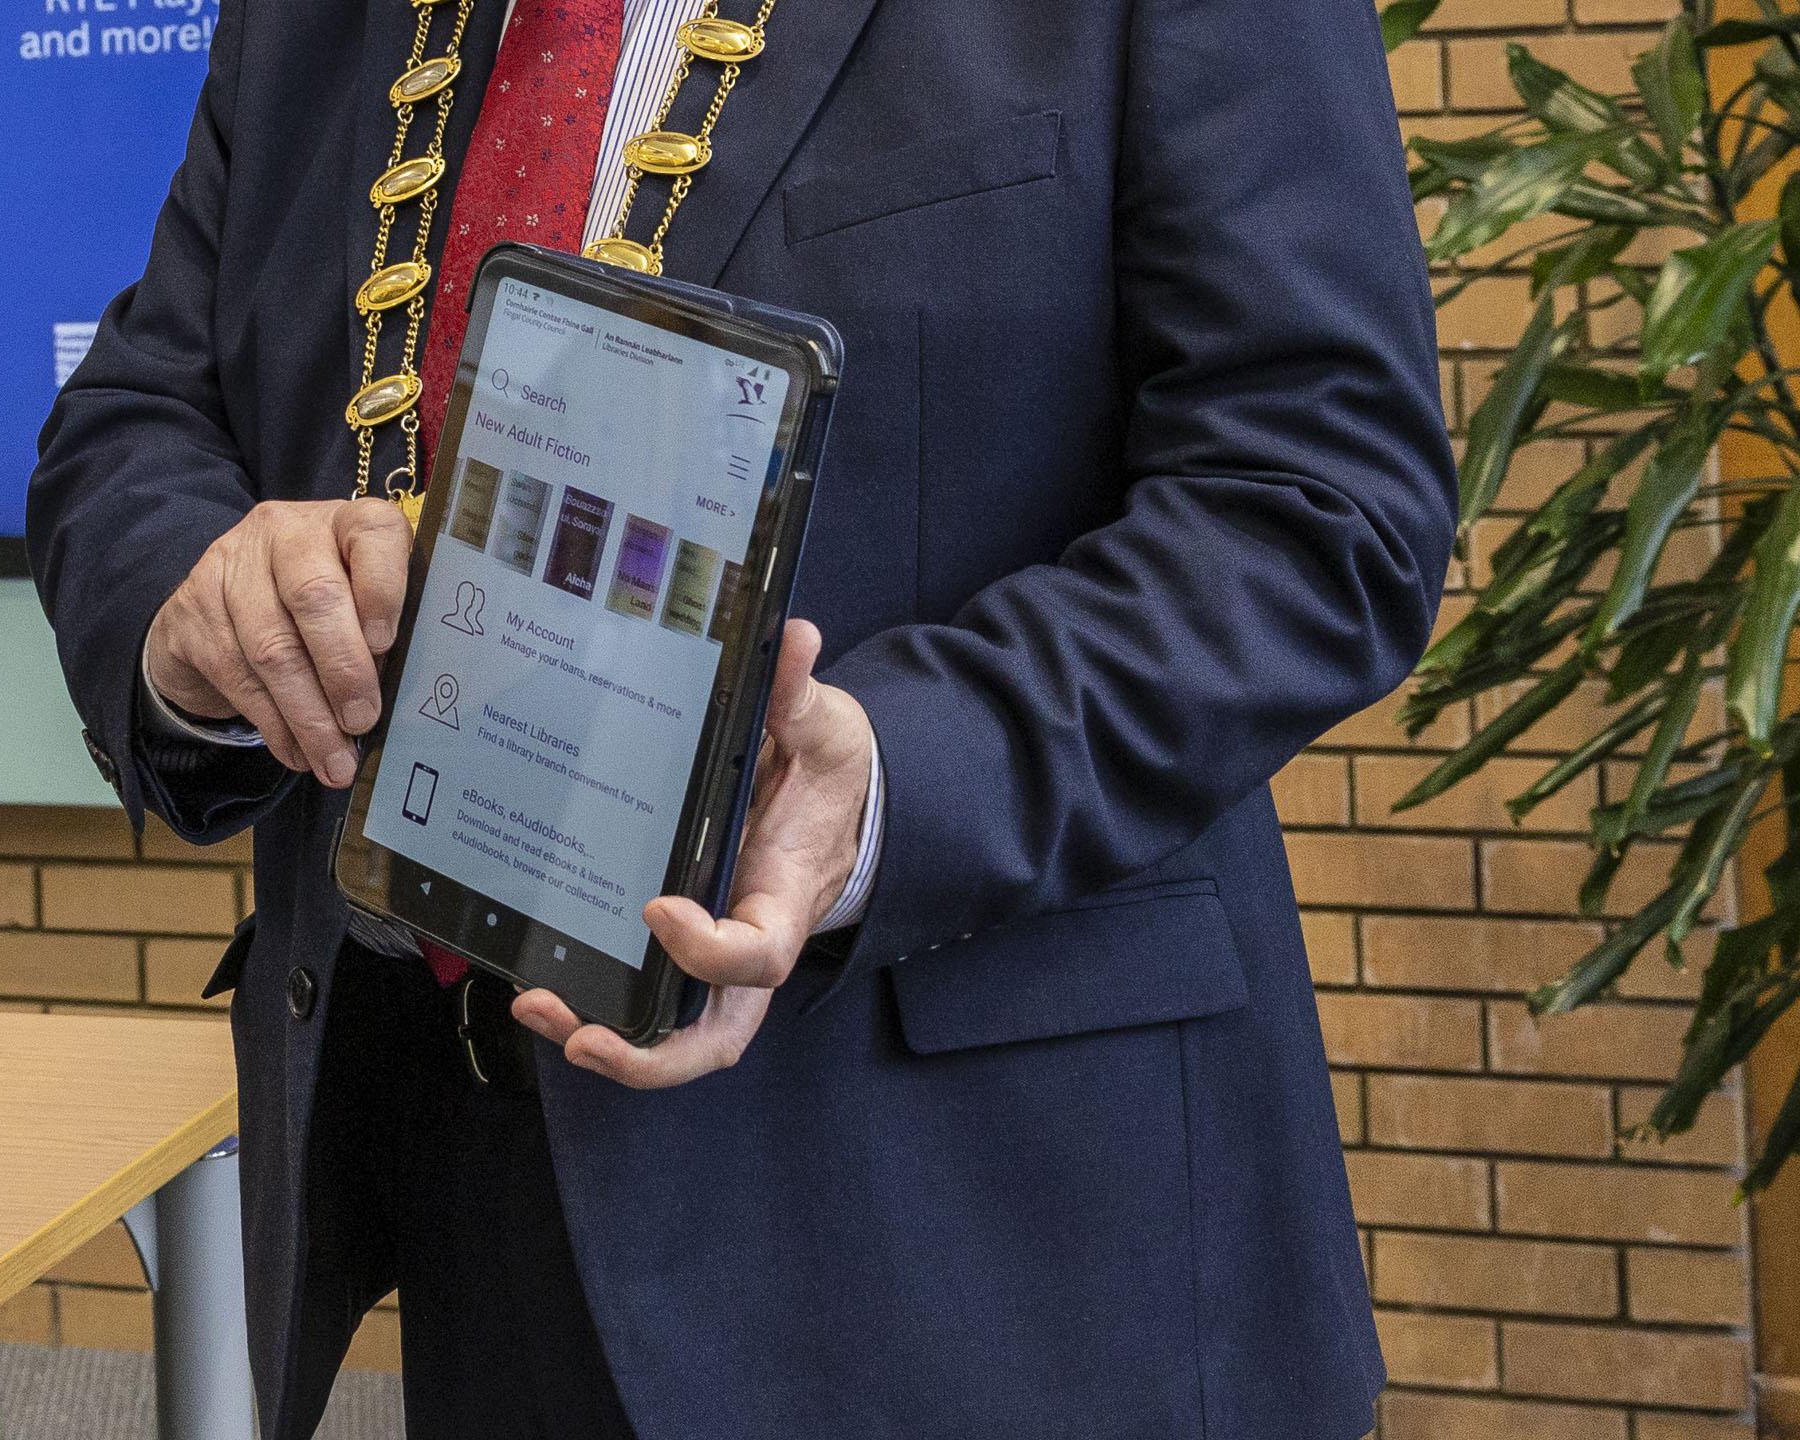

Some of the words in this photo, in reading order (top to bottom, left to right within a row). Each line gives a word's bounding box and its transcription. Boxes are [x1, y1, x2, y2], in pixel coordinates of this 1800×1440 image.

[19, 23, 91, 59] and
[504, 283, 529, 299] 10:44
[503, 309, 521, 321] Fingal
[521, 315, 543, 329] County
[543, 322, 566, 335] Council
[581, 325, 594, 334] Gall
[605, 332, 614, 341] An
[602, 343, 629, 358] Libraries
[521, 385, 567, 413] Search
[475, 411, 505, 434] New
[507, 424, 542, 449] Adult
[545, 437, 590, 467] Fiction
[696, 496, 728, 516] MORE
[507, 611, 523, 631] My
[526, 620, 575, 650] Account
[501, 633, 537, 658] Manage
[538, 651, 559, 666] your
[560, 658, 586, 680] loans,
[588, 672, 645, 704] reservations
[647, 697, 654, 708] &
[657, 701, 681, 719] more
[483, 704, 528, 733] Nearest
[530, 724, 580, 757] Libraries
[478, 727, 497, 743] Find
[499, 739, 505, 747] a
[506, 739, 534, 761] library
[535, 751, 567, 775] branch
[569, 769, 619, 799] convenient
[621, 791, 635, 804] for
[636, 799, 654, 814] you
[463, 789, 506, 819] eBooks,
[457, 809, 501, 838] Download
[502, 832, 520, 847] and
[521, 840, 541, 857] read
[543, 851, 577, 874] eBooks
[579, 867, 586, 880] &
[588, 870, 613, 891] listen
[616, 883, 625, 896] to
[452, 830, 511, 865] eAudiobooks,
[513, 859, 547, 881] browse
[548, 875, 563, 889] our
[565, 883, 610, 912] collection
